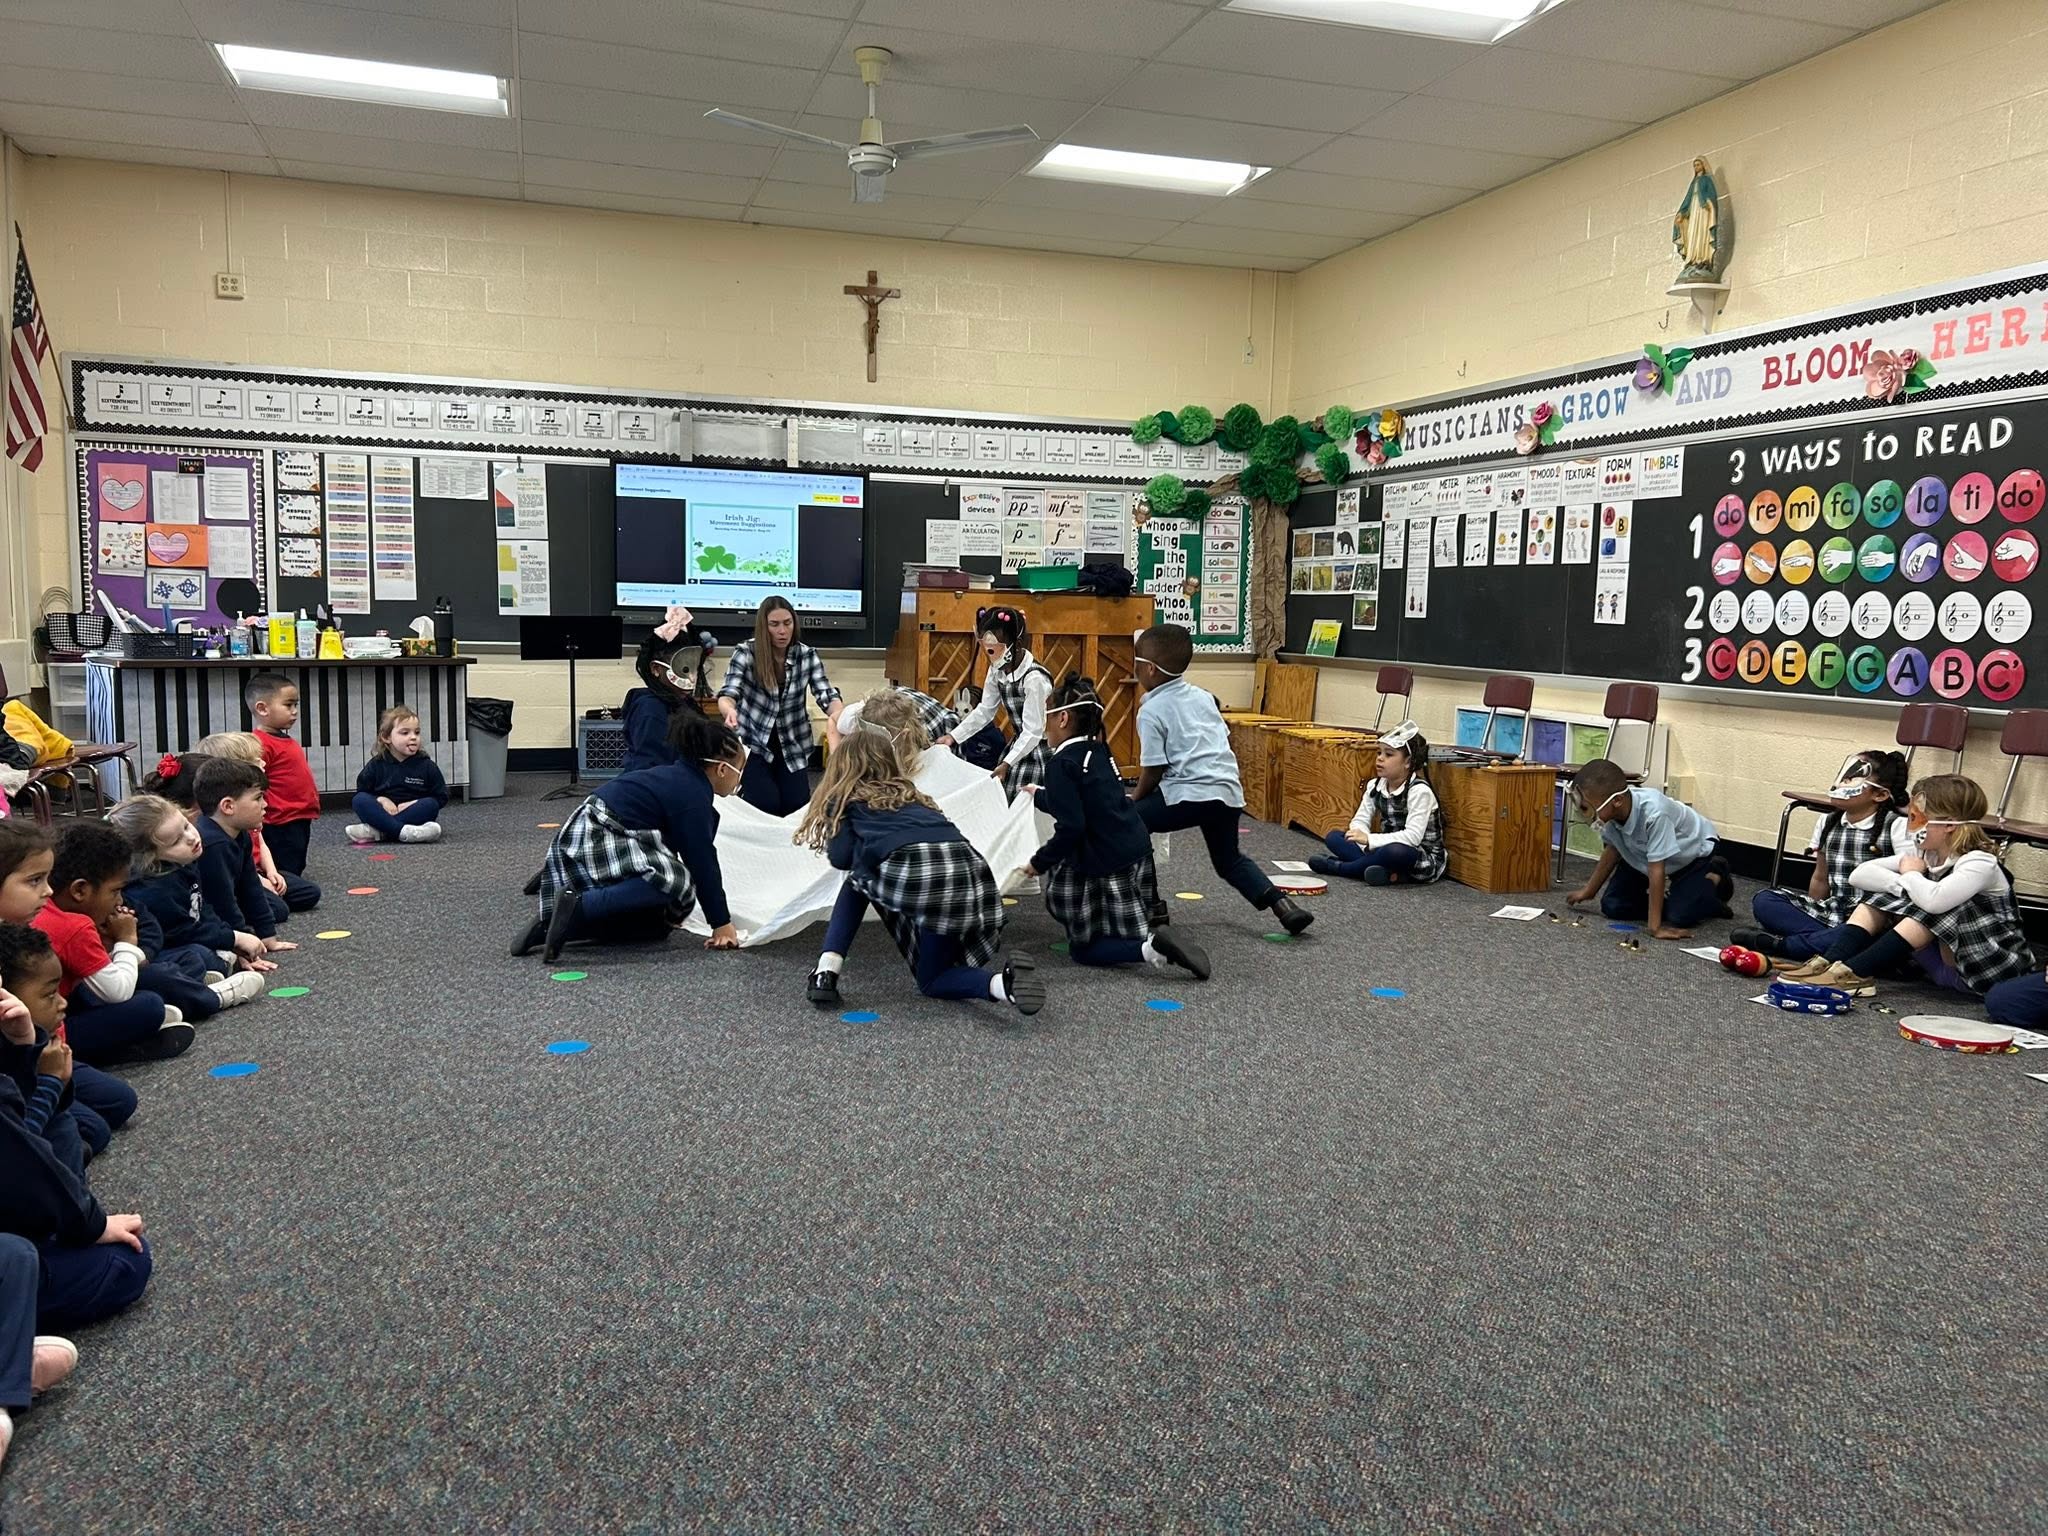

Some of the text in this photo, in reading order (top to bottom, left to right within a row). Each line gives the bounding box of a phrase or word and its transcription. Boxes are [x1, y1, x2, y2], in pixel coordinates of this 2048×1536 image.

[1404, 302, 2048, 451] MUSICIANS GROW AND BLOOM HER
[1729, 417, 2013, 484] 3 WAYS to READ
[1606, 457, 1632, 472] FORM
[1644, 454, 1679, 472] TIMBRE
[1467, 474, 1492, 485] RHYTHM
[1537, 468, 1555, 479] MOOD
[1565, 467, 1596, 480] TEXTURE
[1385, 486, 1400, 495] PITCH
[1411, 482, 1429, 491] MELODY
[1439, 478, 1459, 490] METER
[1340, 491, 1356, 501] TEMPO
[1048, 500, 1070, 517] mf
[1605, 509, 1612, 522] A
[1689, 479, 2041, 559] 1 do re mi fa so la ti do'
[1146, 520, 1198, 531] whooo can
[1214, 525, 1220, 534] ti
[1411, 522, 1429, 530] MELODY
[1618, 518, 1625, 532] B
[1012, 529, 1023, 543] p
[1051, 528, 1065, 545] f
[1153, 535, 1178, 549] sing
[1167, 551, 1185, 563] the
[1156, 566, 1184, 579] pitch
[1210, 573, 1218, 582] fa
[1146, 582, 1182, 593] ladder?
[1155, 596, 1189, 609] whoo,
[1684, 586, 1704, 630] 2
[1208, 623, 1218, 631] do
[1681, 638, 2019, 692] 3 C D E F G A B C'
